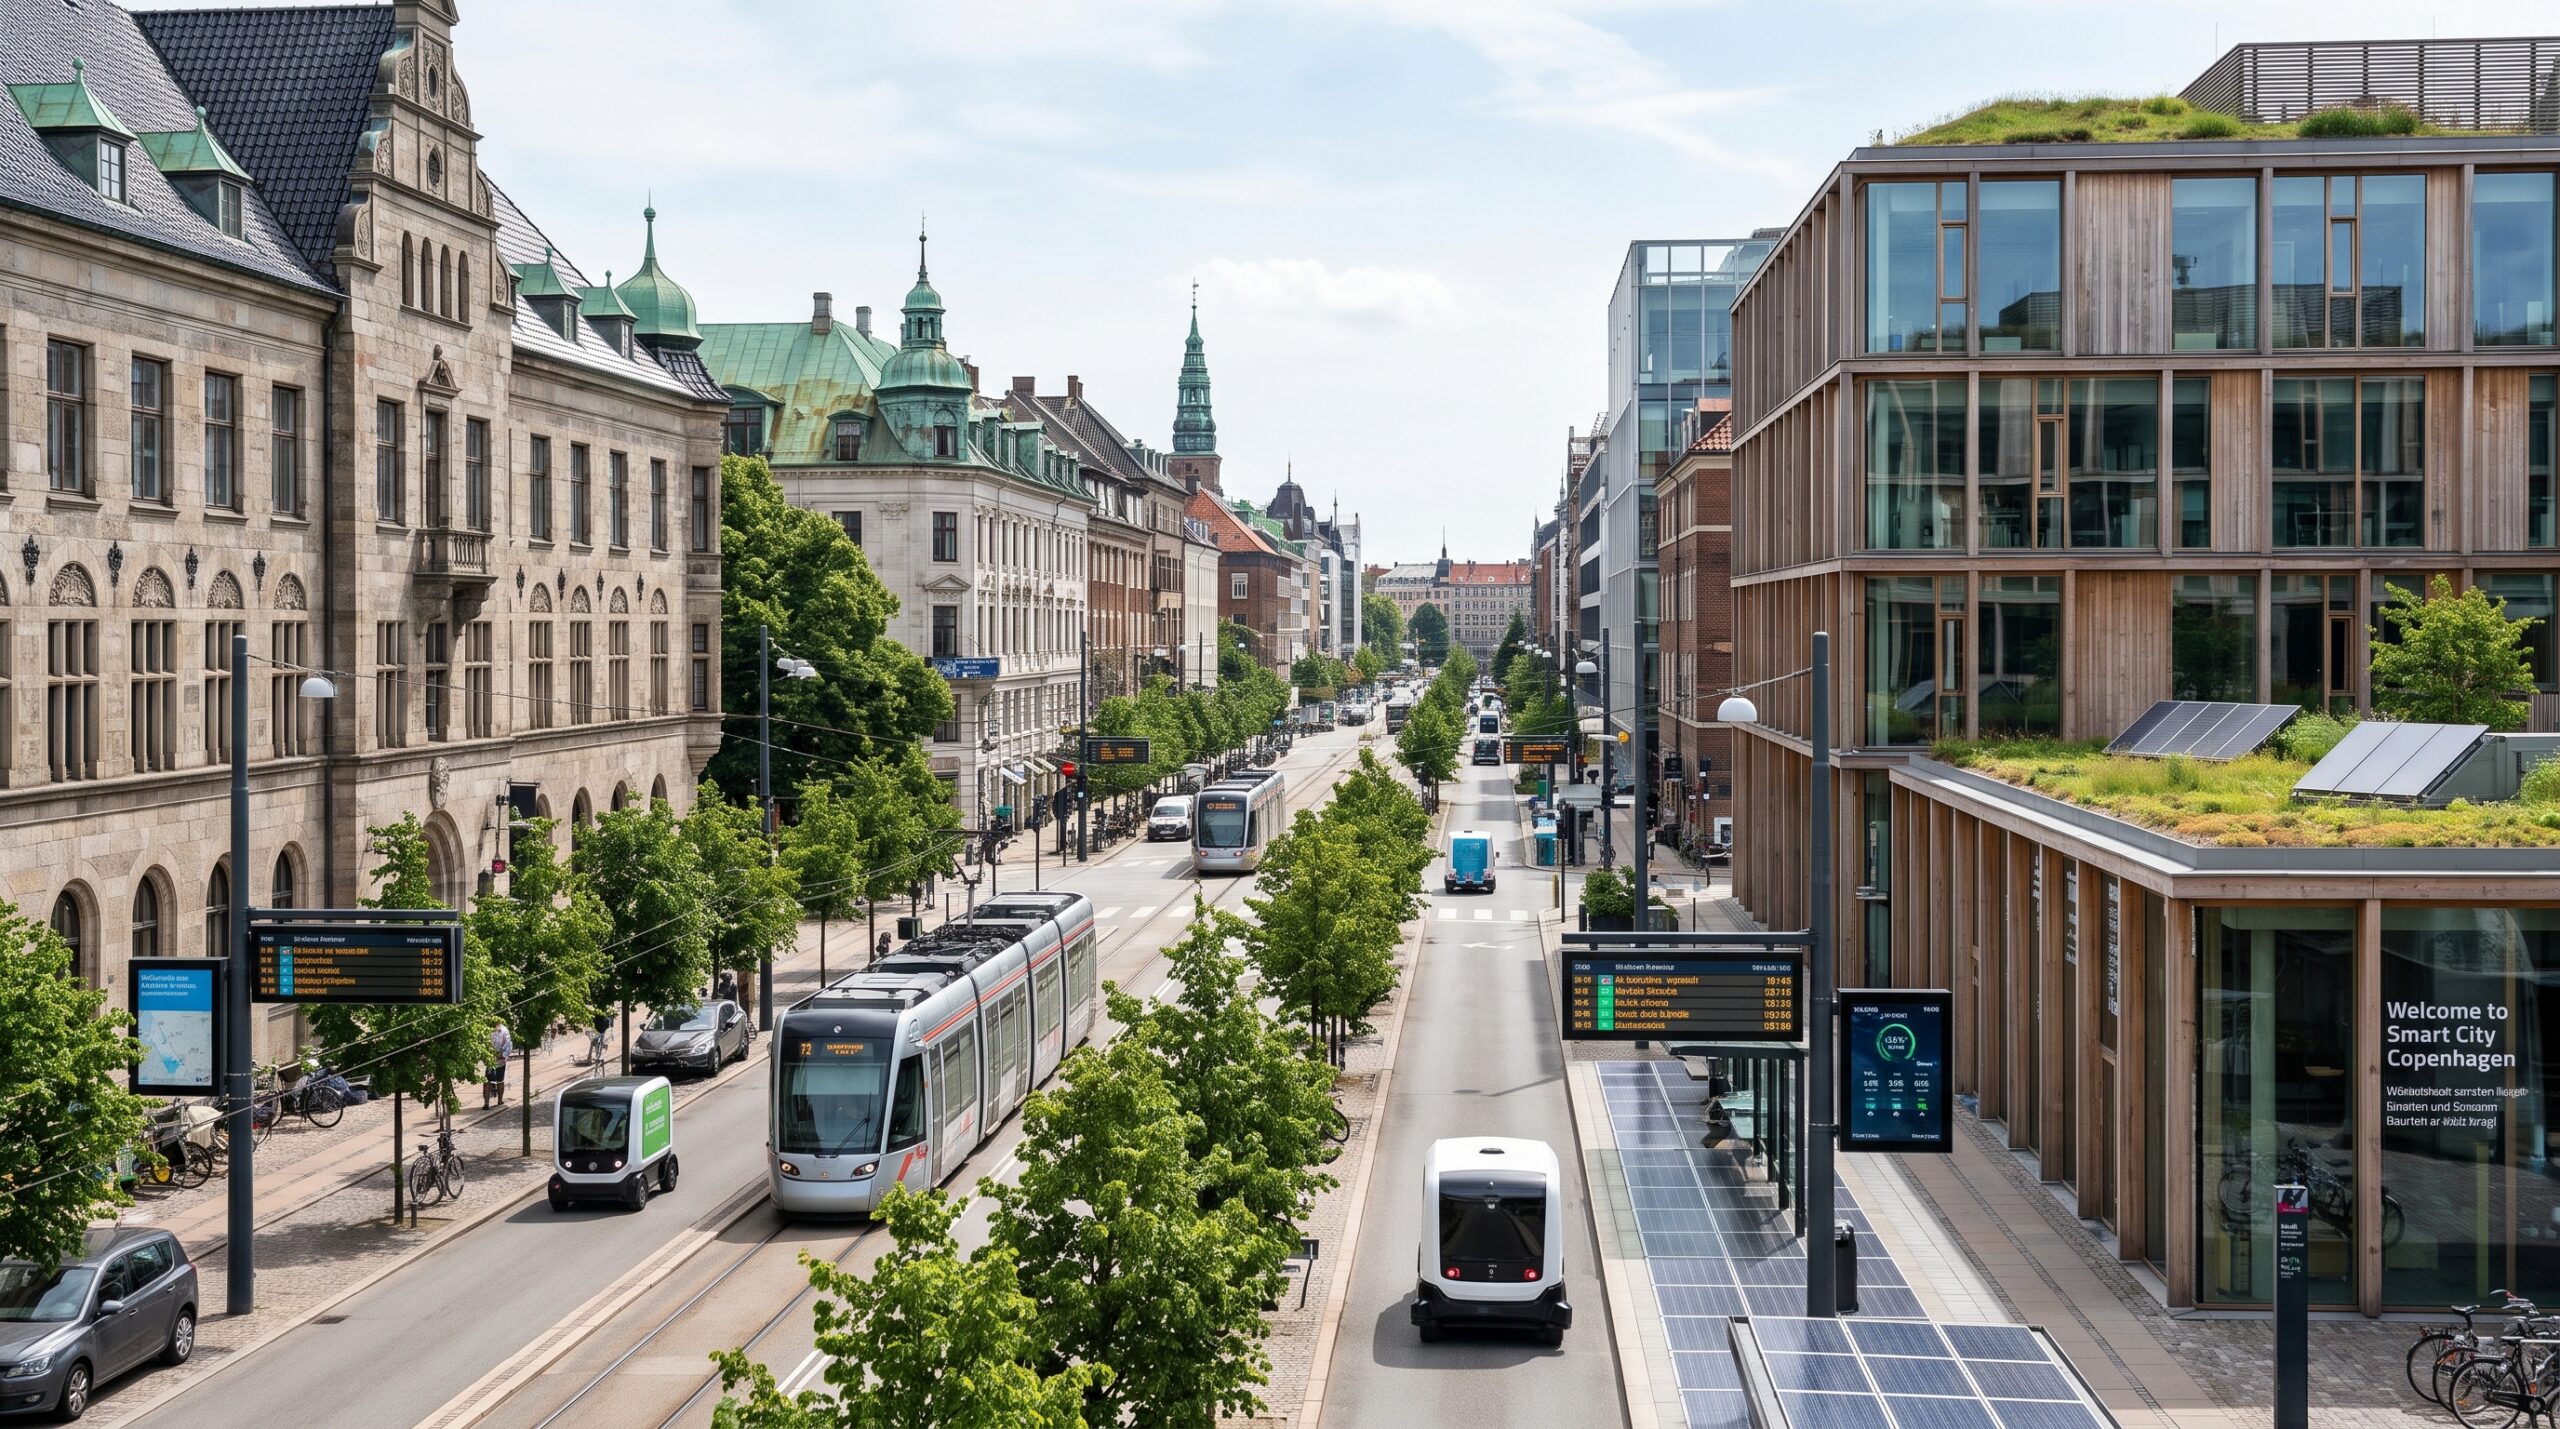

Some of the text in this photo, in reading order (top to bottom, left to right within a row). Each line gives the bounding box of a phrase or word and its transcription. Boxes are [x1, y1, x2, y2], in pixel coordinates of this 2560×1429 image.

[2387, 1002, 2509, 1020] Welcome to
[2387, 1025, 2496, 1047] Smart City
[2387, 1049, 2516, 1072] Copenhagen
[2431, 1102, 2450, 1112] und
